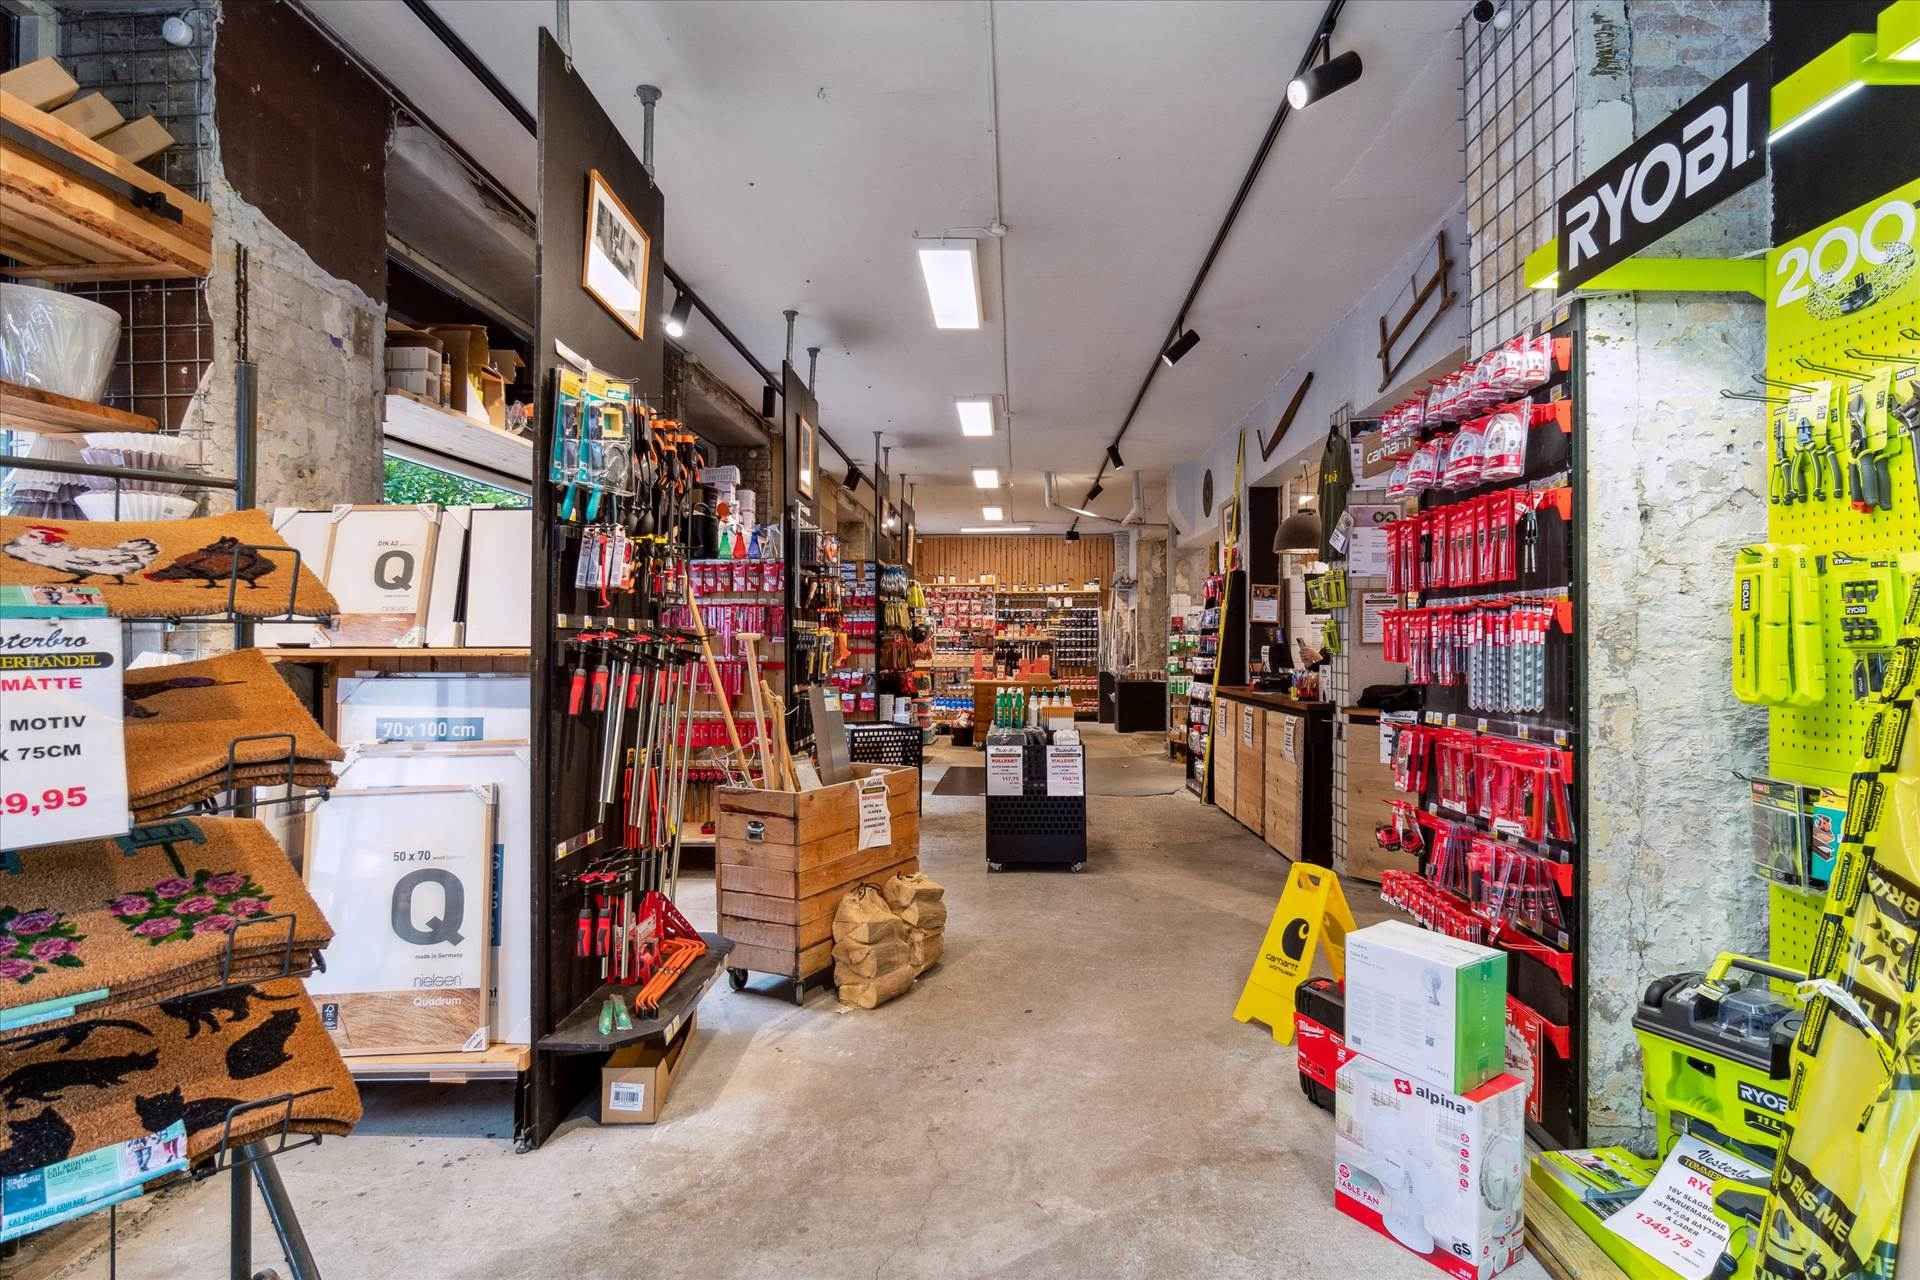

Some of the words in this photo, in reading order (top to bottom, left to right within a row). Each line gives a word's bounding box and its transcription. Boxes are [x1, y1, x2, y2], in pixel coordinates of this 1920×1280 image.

[1566, 82, 1749, 271] RYOBI
[374, 550, 415, 591] Q
[1741, 580, 1750, 610] RYOBI
[10, 715, 87, 732] MOTIV
[383, 722, 401, 737] 70
[404, 725, 414, 737] x
[420, 722, 447, 737] 100
[452, 723, 476, 737] cm
[17, 744, 81, 760] 75CM
[0, 786, 88, 816] 9,95
[393, 851, 406, 861] 50
[409, 853, 415, 861] x
[418, 851, 431, 861] 70
[391, 868, 465, 946] Q
[1415, 1086, 1467, 1116] alpina
[1363, 1190, 1380, 1206] FAN
[1634, 1212, 1694, 1249] 1349,75
[1453, 1242, 1472, 1256] GS
